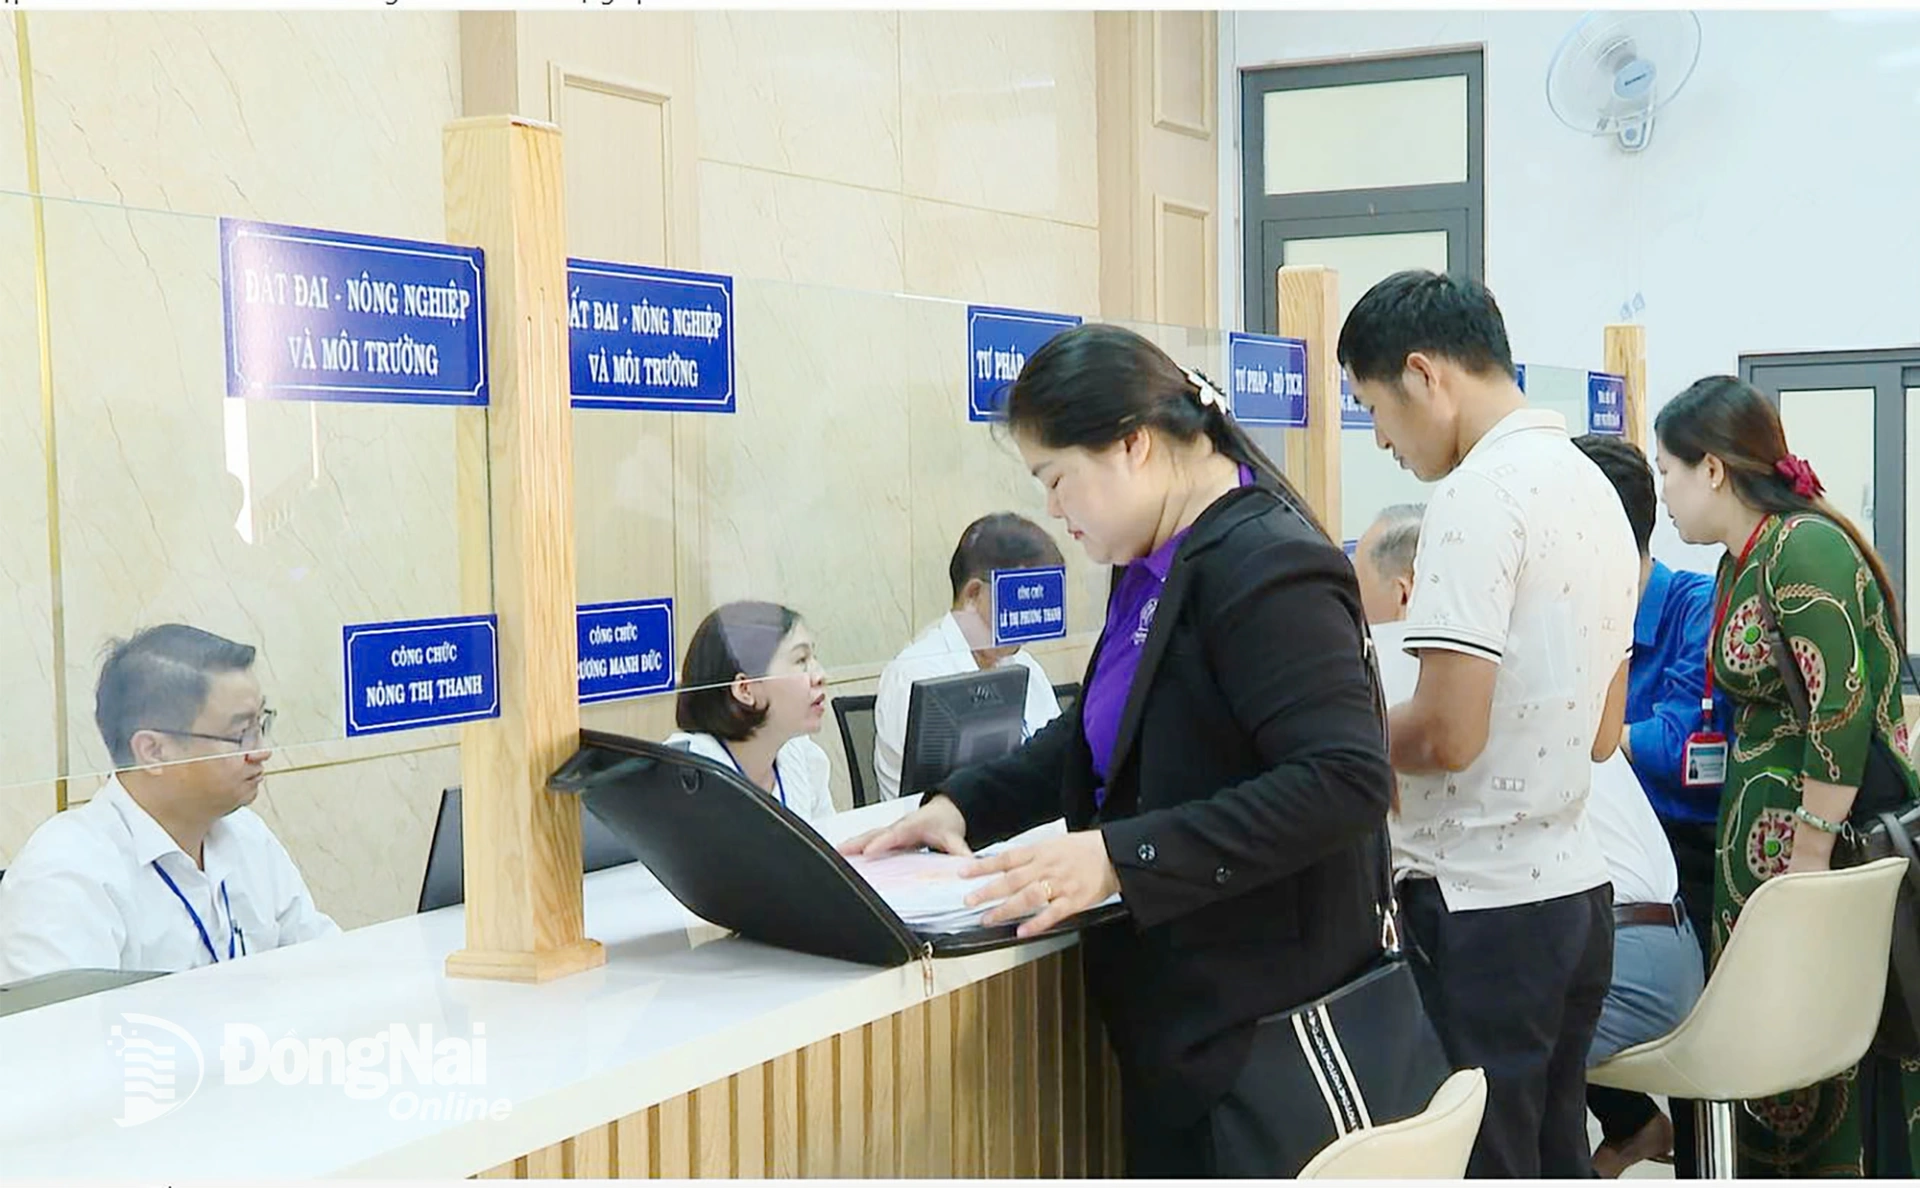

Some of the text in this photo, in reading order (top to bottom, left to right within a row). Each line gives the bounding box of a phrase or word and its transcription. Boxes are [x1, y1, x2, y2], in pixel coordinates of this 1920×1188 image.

[293, 274, 329, 309] ĐAI
[347, 271, 398, 317] NÔNG
[403, 279, 471, 327] NGHIỆP
[568, 286, 590, 330] ẤT
[593, 301, 619, 332] ĐAI
[631, 297, 669, 336] NÔNG
[672, 304, 722, 345] NGHIỆP
[288, 327, 440, 376] VÀ MÔI TRƯỜNG
[588, 346, 699, 388] VÀ MÔI TRƯỜNG
[976, 343, 1025, 381] TƯ PHÁP
[1247, 363, 1268, 395] PHÁP
[588, 621, 638, 646] CÔNG CHỨC
[391, 640, 458, 667] CÔNG CHỨC
[578, 648, 663, 680] ƯƠNG MẠNH ĐỨC
[365, 674, 483, 707] NÔNG THỊ THANH
